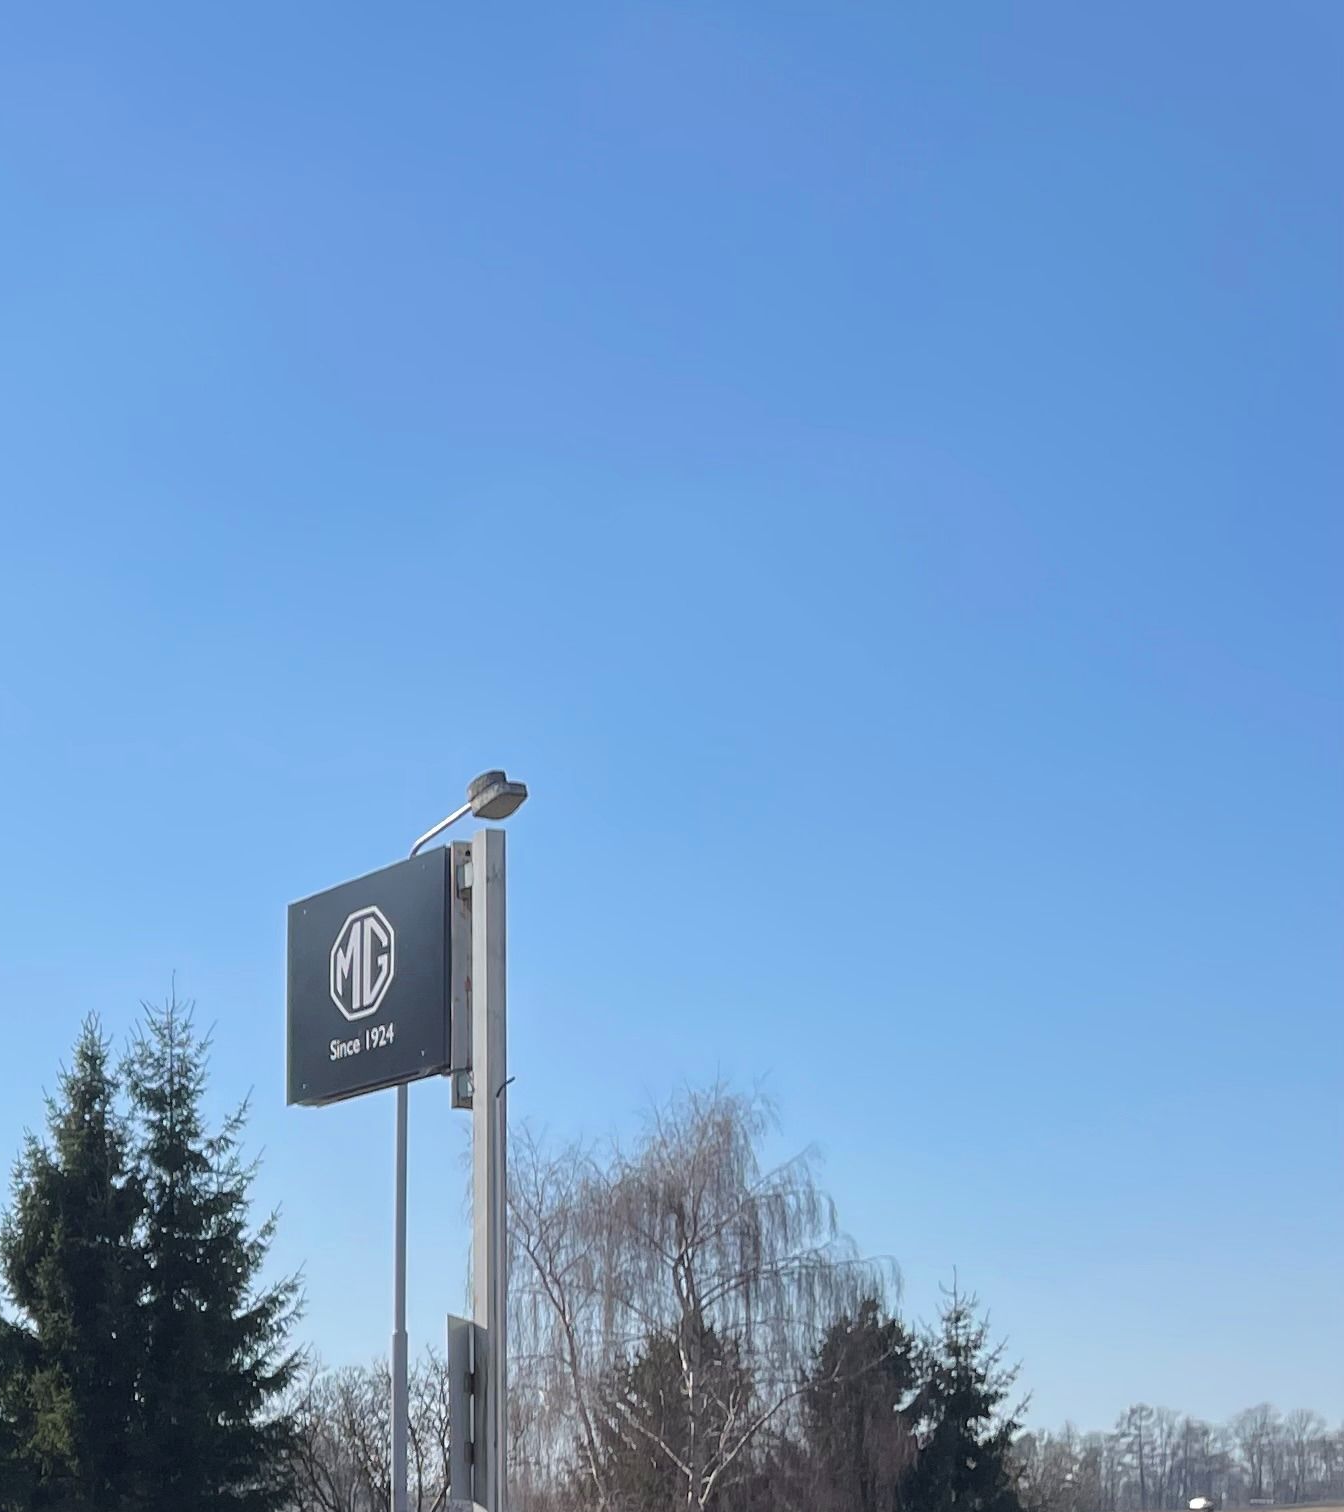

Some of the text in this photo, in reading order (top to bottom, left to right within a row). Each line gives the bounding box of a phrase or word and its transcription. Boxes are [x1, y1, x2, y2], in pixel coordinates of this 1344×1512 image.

[336, 915, 389, 1010] MG
[330, 1022, 394, 1061] Since 1924
